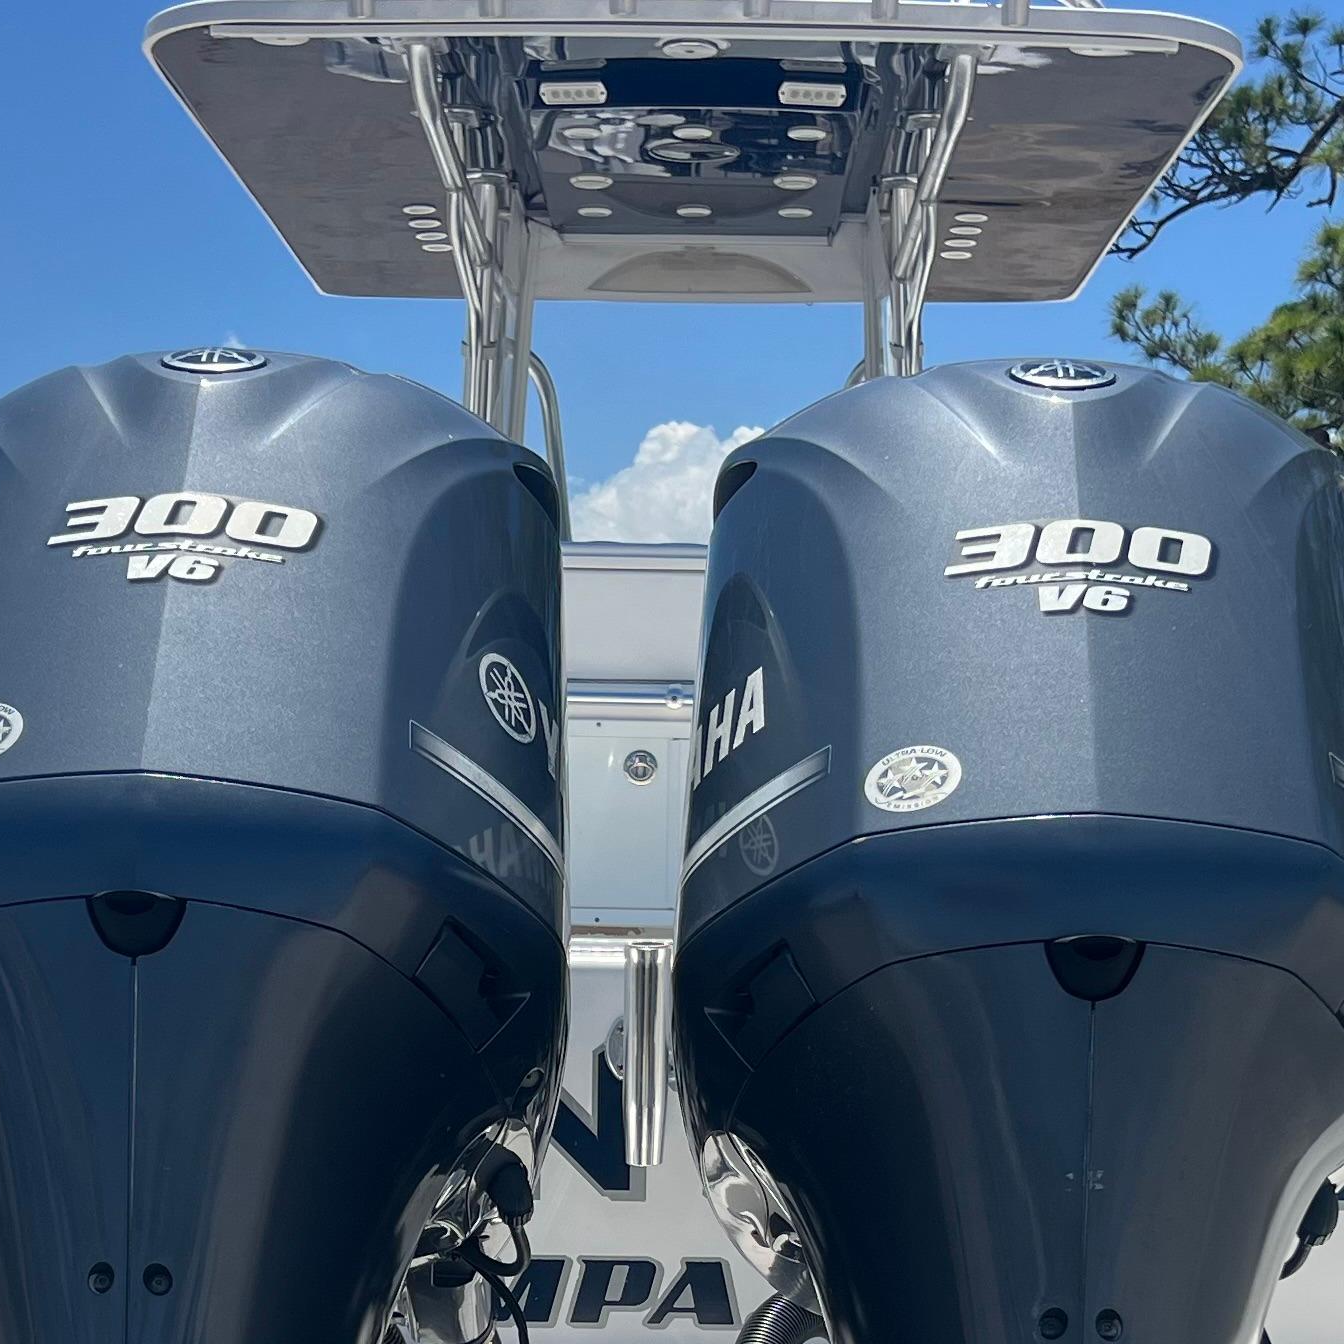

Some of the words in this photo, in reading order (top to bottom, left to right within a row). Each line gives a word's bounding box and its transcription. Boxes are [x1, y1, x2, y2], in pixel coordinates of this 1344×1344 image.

[47, 492, 318, 548] 300
[127, 553, 219, 580] V6
[944, 519, 1212, 576] 300
[1038, 584, 1130, 612] V6
